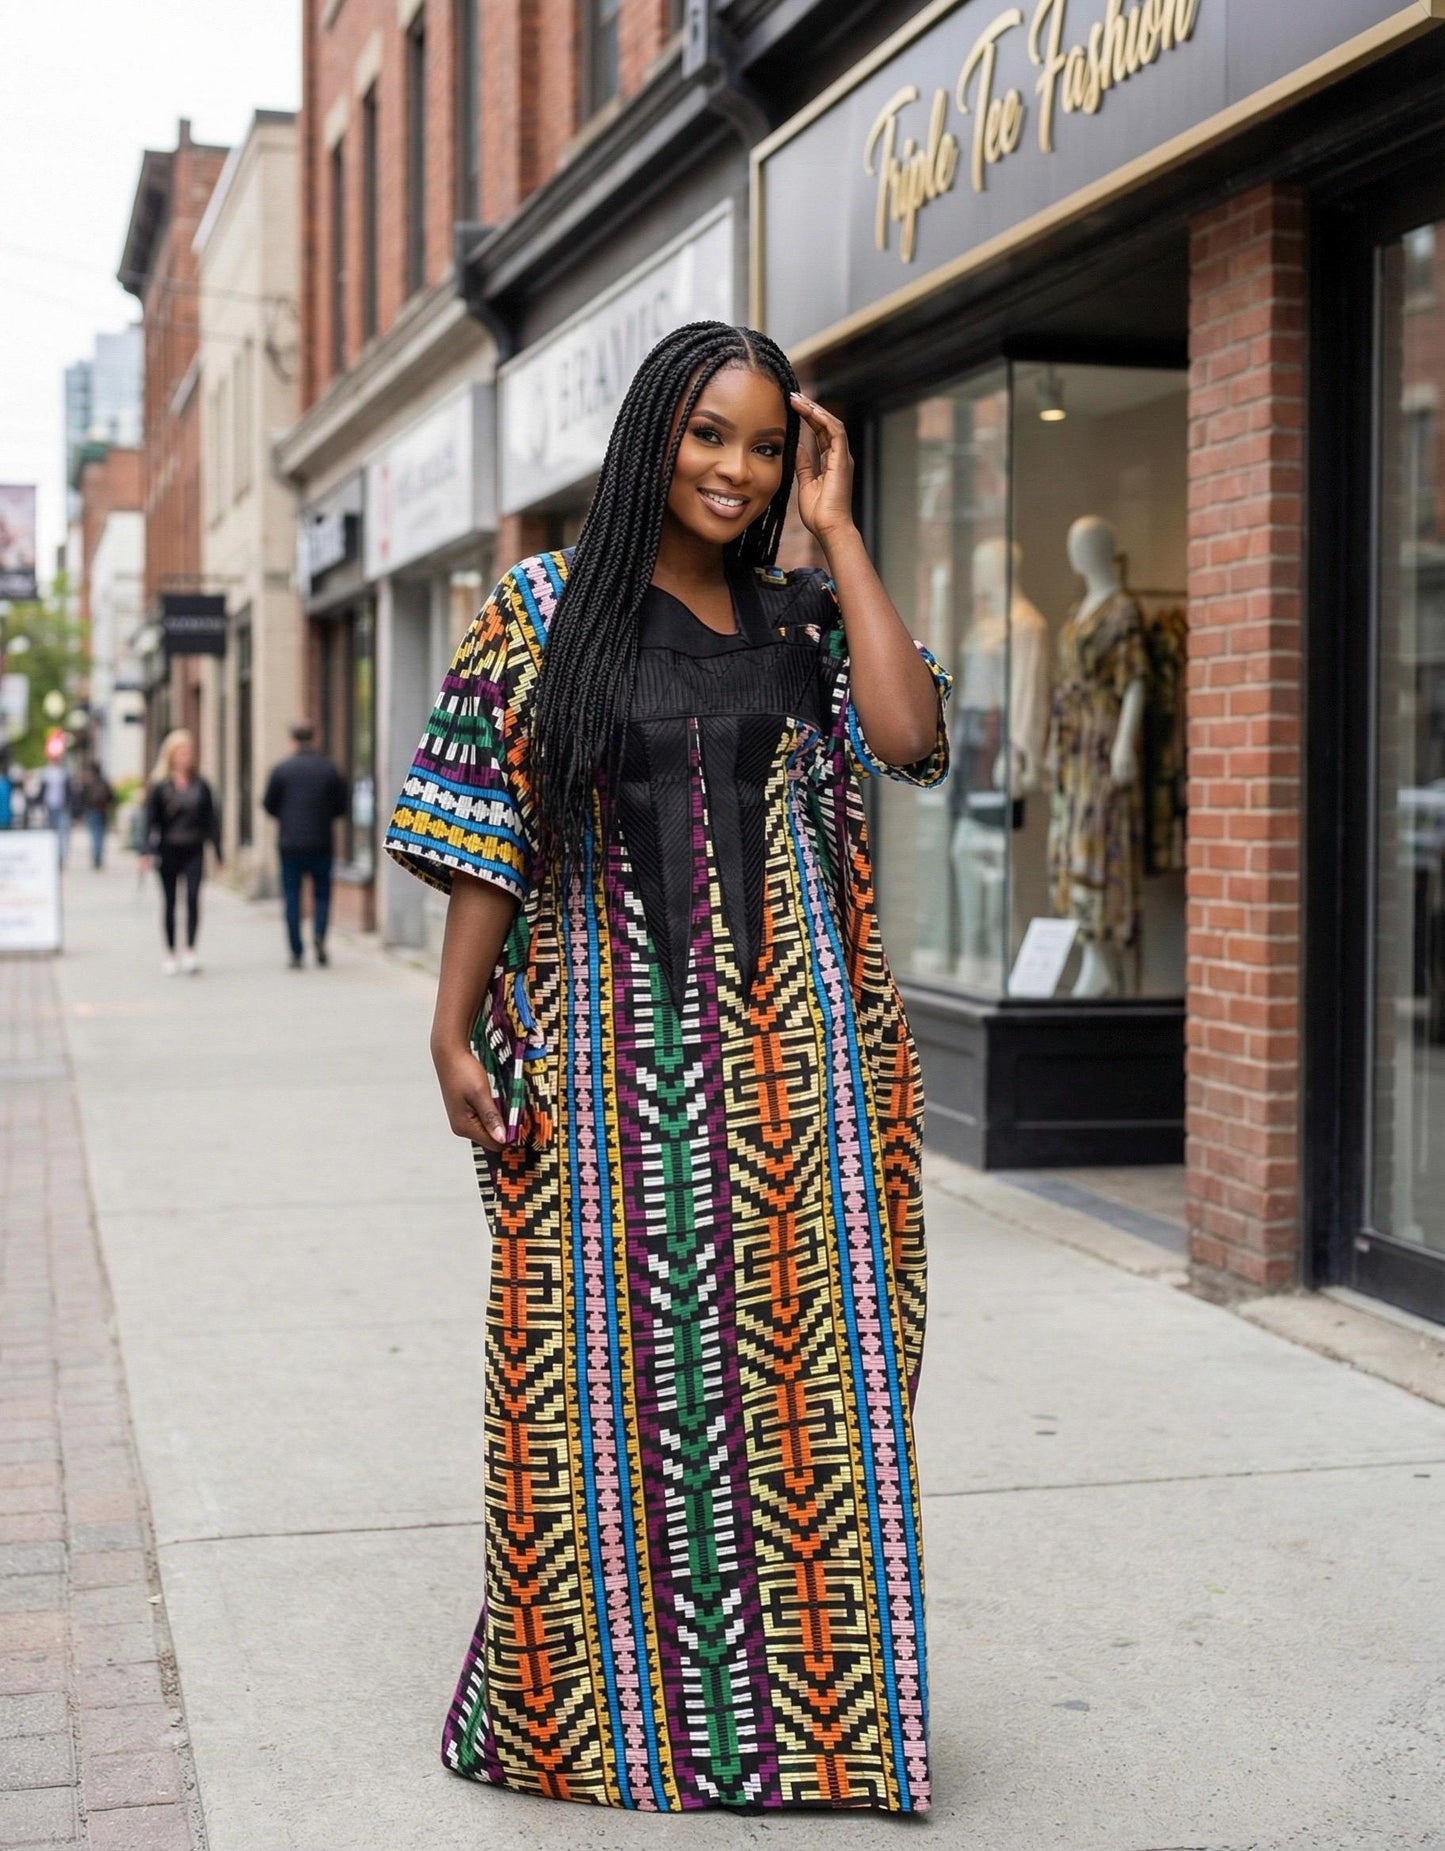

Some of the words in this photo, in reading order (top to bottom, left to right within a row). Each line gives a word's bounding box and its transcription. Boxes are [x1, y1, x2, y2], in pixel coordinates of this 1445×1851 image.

[863, 84, 959, 264] Triple
[956, 7, 1025, 193] Tee
[1028, 0, 1199, 153] Fashion
